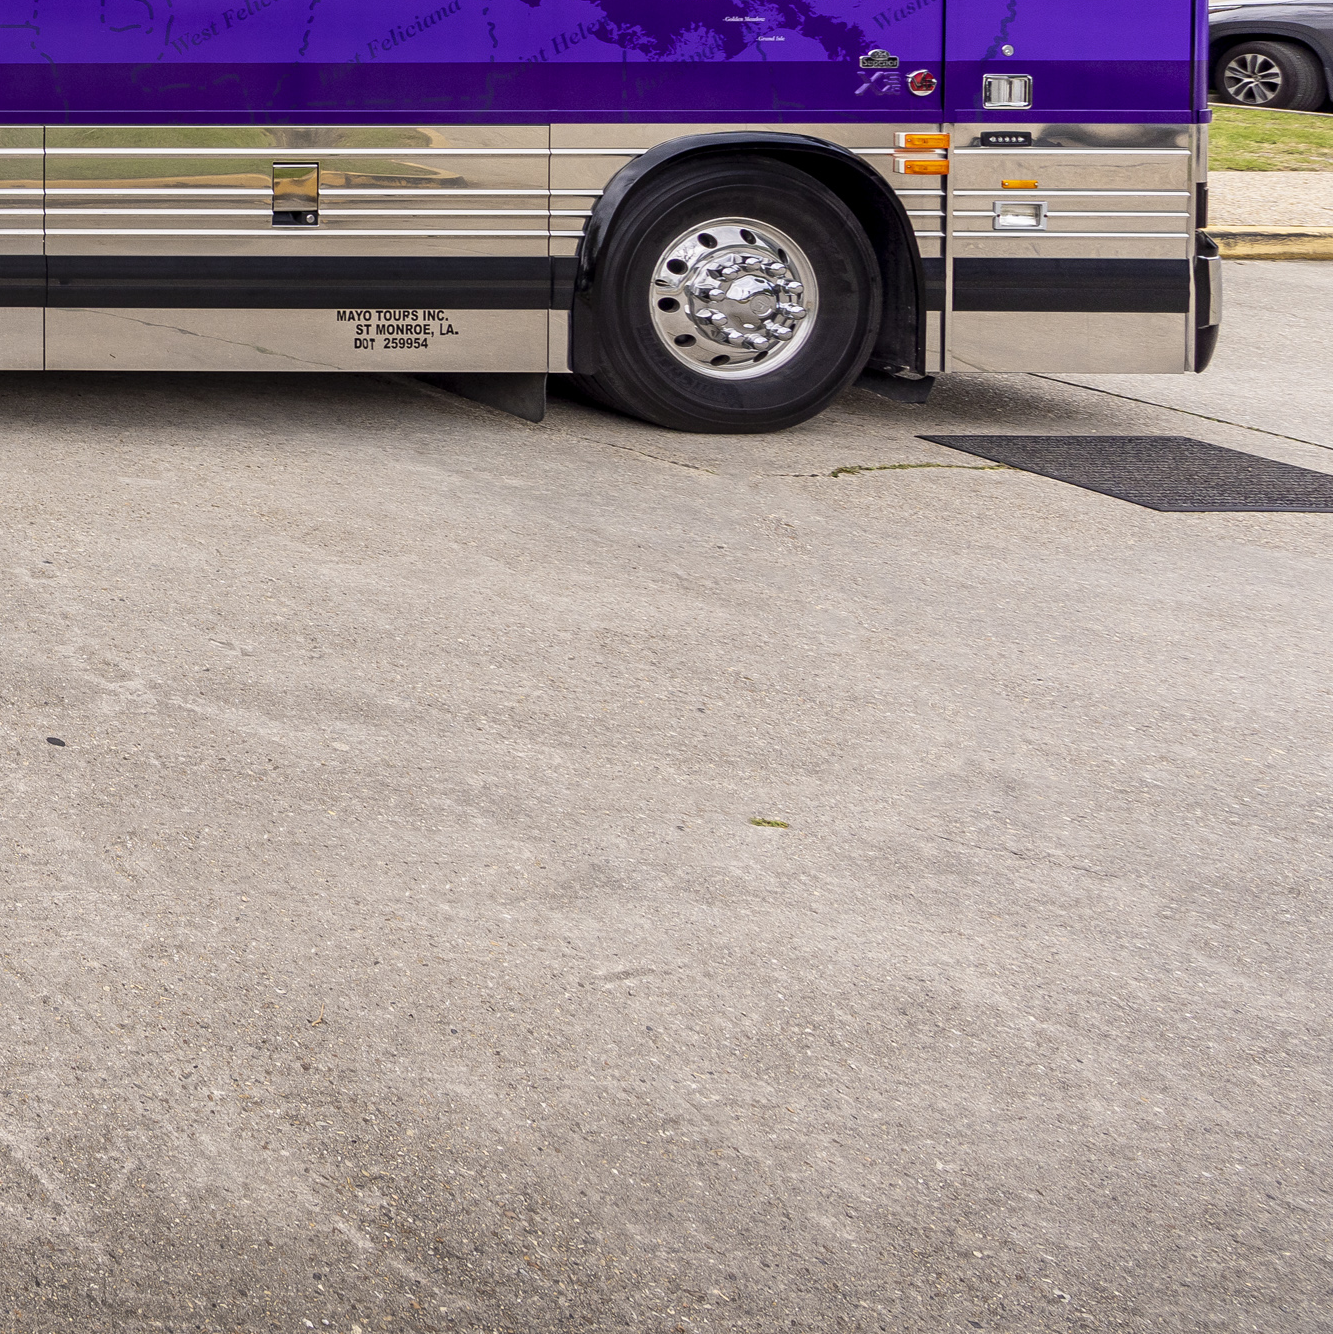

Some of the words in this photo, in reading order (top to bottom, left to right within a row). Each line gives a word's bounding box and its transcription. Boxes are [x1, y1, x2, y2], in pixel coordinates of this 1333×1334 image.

[168, 12, 221, 58] West
[336, 310, 372, 322] MAYO
[422, 310, 449, 322] INC.
[355, 324, 372, 335] ST
[375, 324, 434, 337] MONROE,
[439, 323, 459, 336] LA.
[354, 337, 375, 350] DOT
[383, 337, 429, 349] 259954
